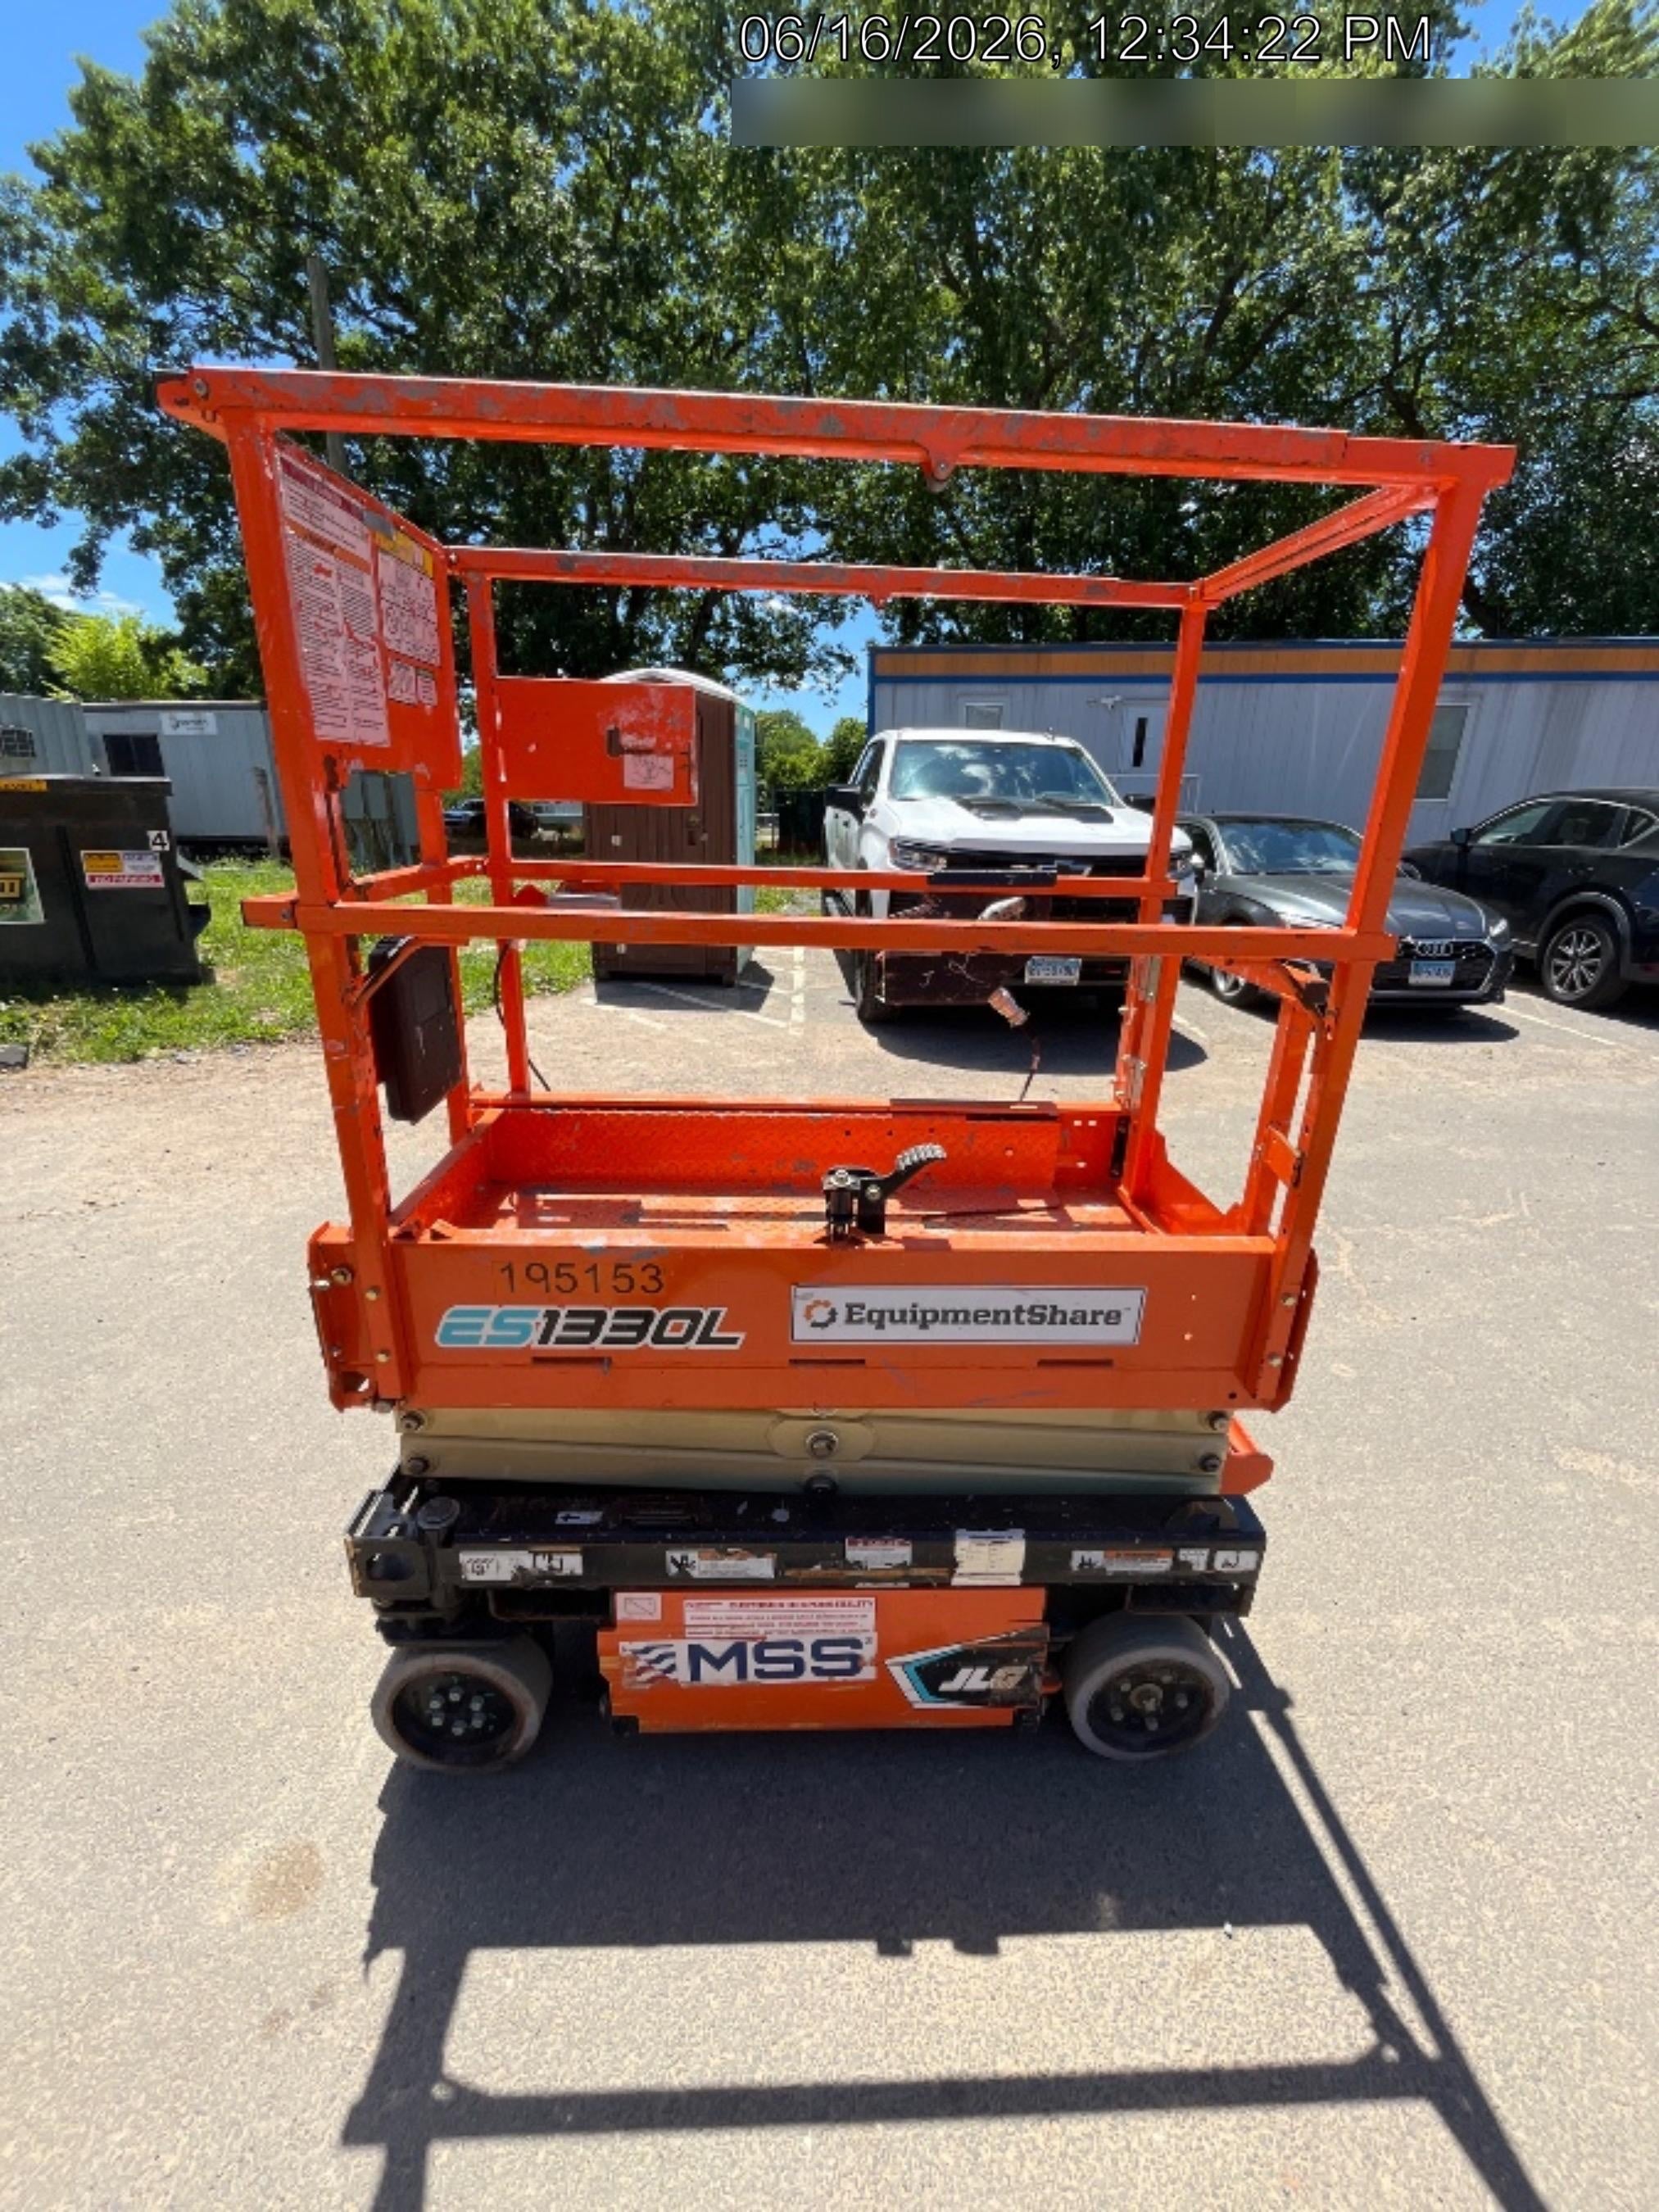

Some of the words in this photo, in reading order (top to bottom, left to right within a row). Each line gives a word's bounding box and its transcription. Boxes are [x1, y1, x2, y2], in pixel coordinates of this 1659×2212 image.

[152, 832, 167, 850] 4
[501, 1262, 665, 1294] 195153
[435, 1305, 746, 1349] ES1330L
[844, 1303, 1122, 1330] EquipmentShare
[687, 1638, 864, 1682] MSS
